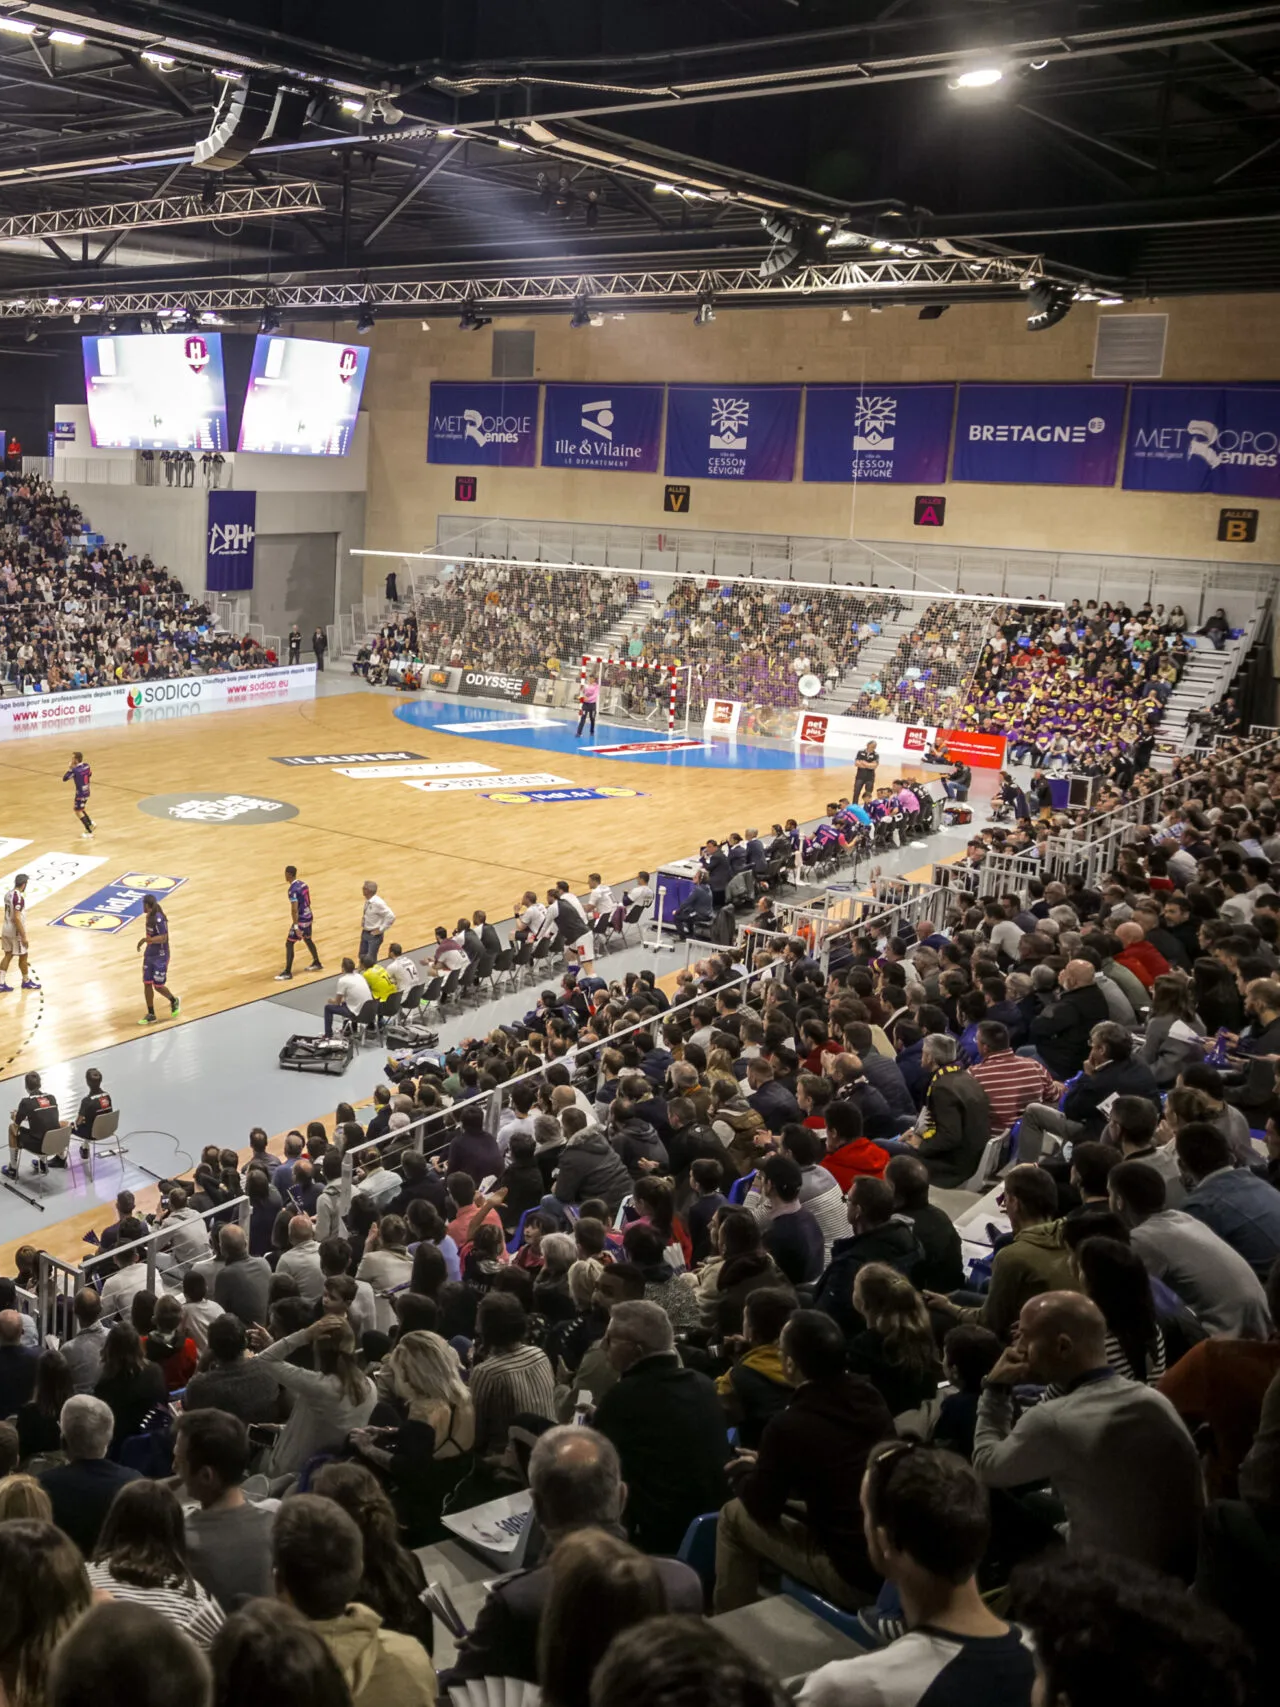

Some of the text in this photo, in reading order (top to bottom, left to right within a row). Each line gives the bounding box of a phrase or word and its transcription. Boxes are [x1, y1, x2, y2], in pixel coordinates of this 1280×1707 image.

[969, 425, 1086, 443] BRETAGNE
[1135, 420, 1280, 458] METROPO
[555, 439, 642, 458] Ille & Vilaine
[708, 457, 746, 467] CESSON
[708, 465, 745, 475] SÉVIGNÉ
[852, 460, 893, 469] CESSON
[852, 468, 892, 478] SÉVIGNÉ
[460, 485, 472, 501] U
[670, 495, 684, 511] V
[920, 506, 939, 525] A
[1226, 520, 1247, 541] B
[227, 679, 289, 695] www.sodico.eu
[466, 673, 524, 690] ODYSSEE
[145, 682, 201, 703] SODICO
[13, 703, 91, 722] www.sodico.eu
[808, 719, 822, 728] net
[806, 728, 821, 737] plus
[909, 731, 922, 739] net
[907, 738, 921, 747] plus
[95, 889, 147, 913] lidl.fr
[406, 966, 417, 980] 14
